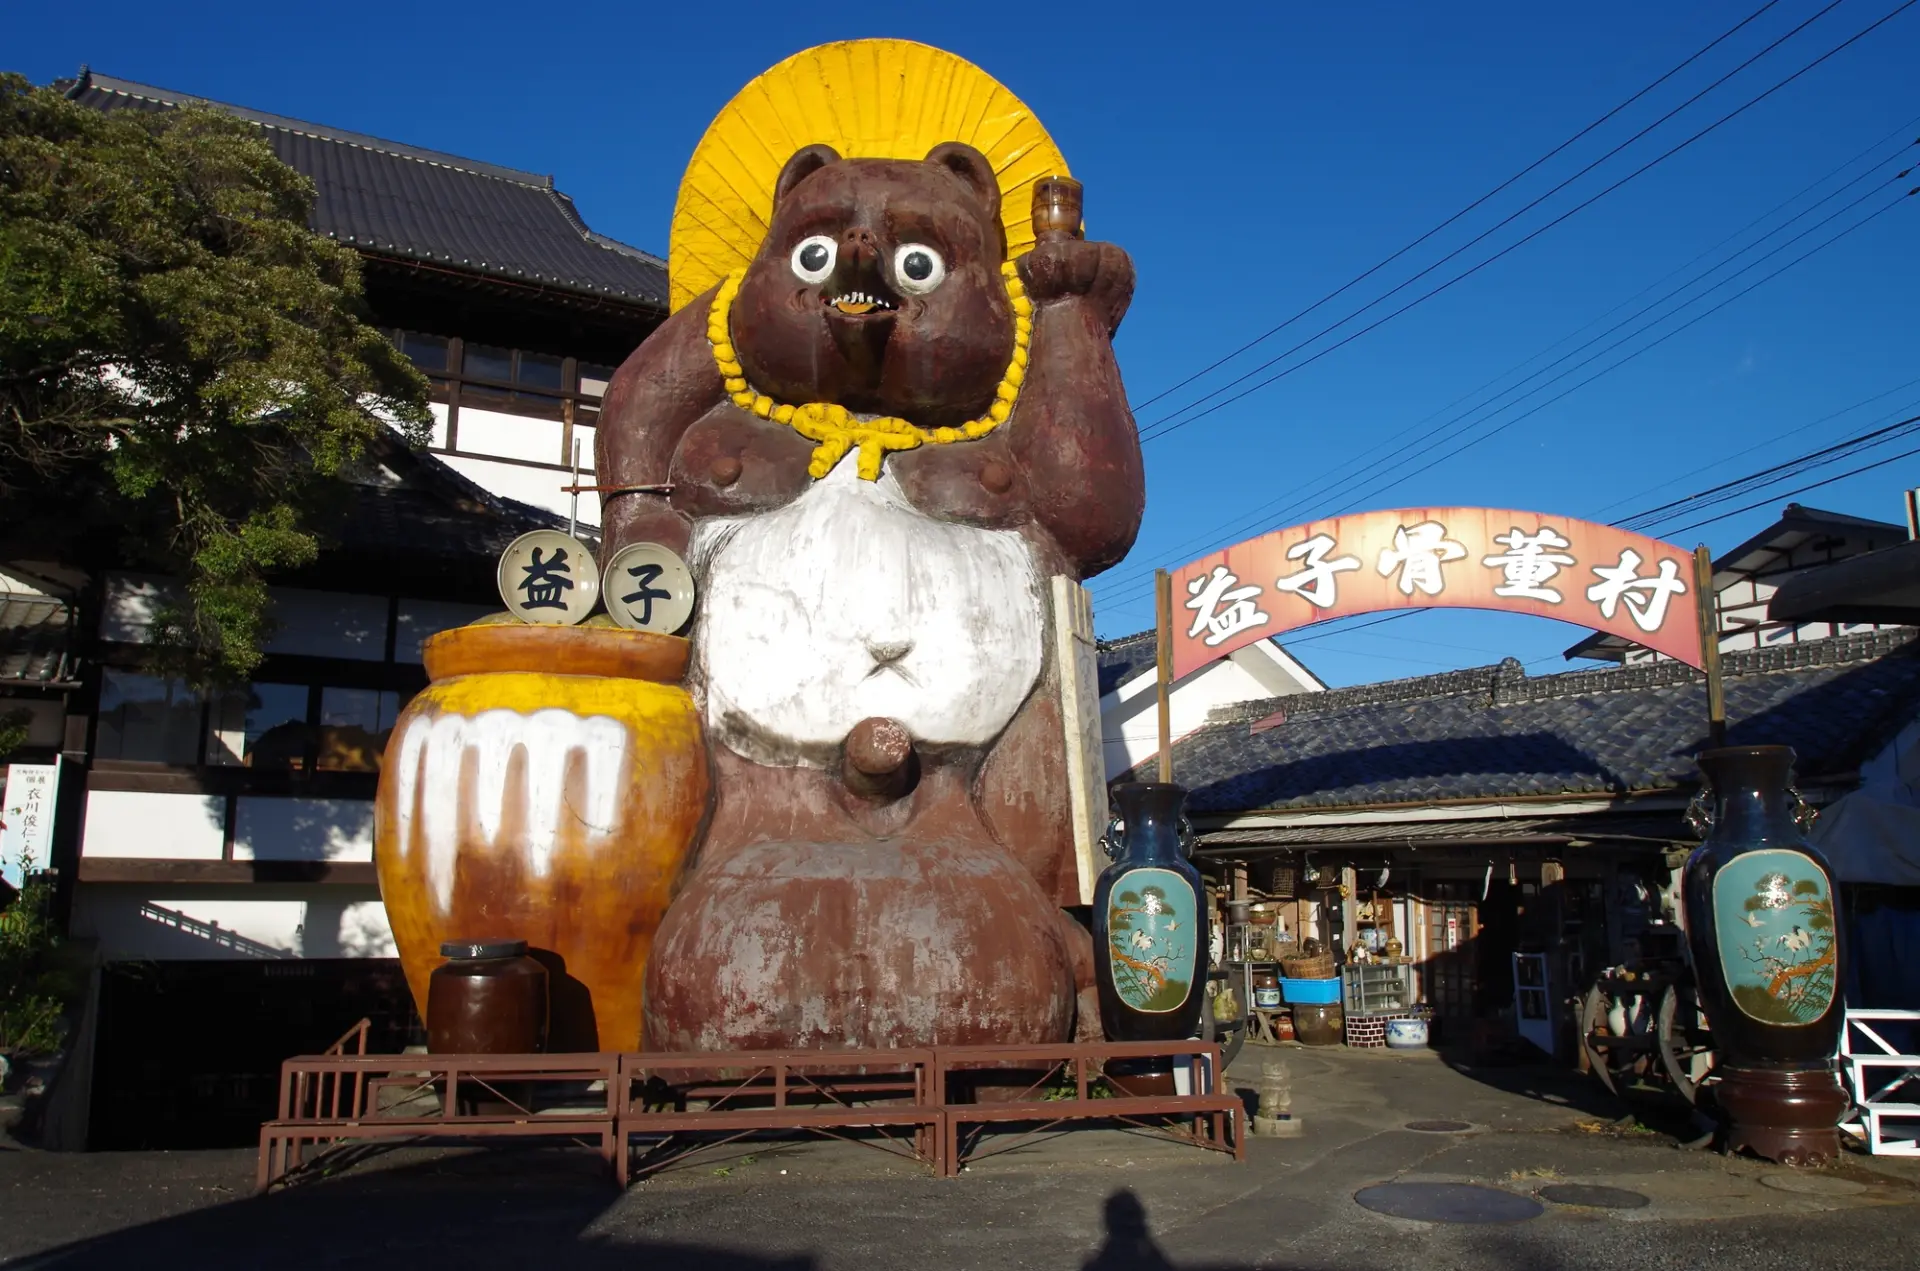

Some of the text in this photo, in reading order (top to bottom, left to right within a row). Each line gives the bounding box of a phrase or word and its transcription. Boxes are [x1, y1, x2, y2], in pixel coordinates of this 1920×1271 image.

[1187, 521, 1687, 646] 益子骨董村
